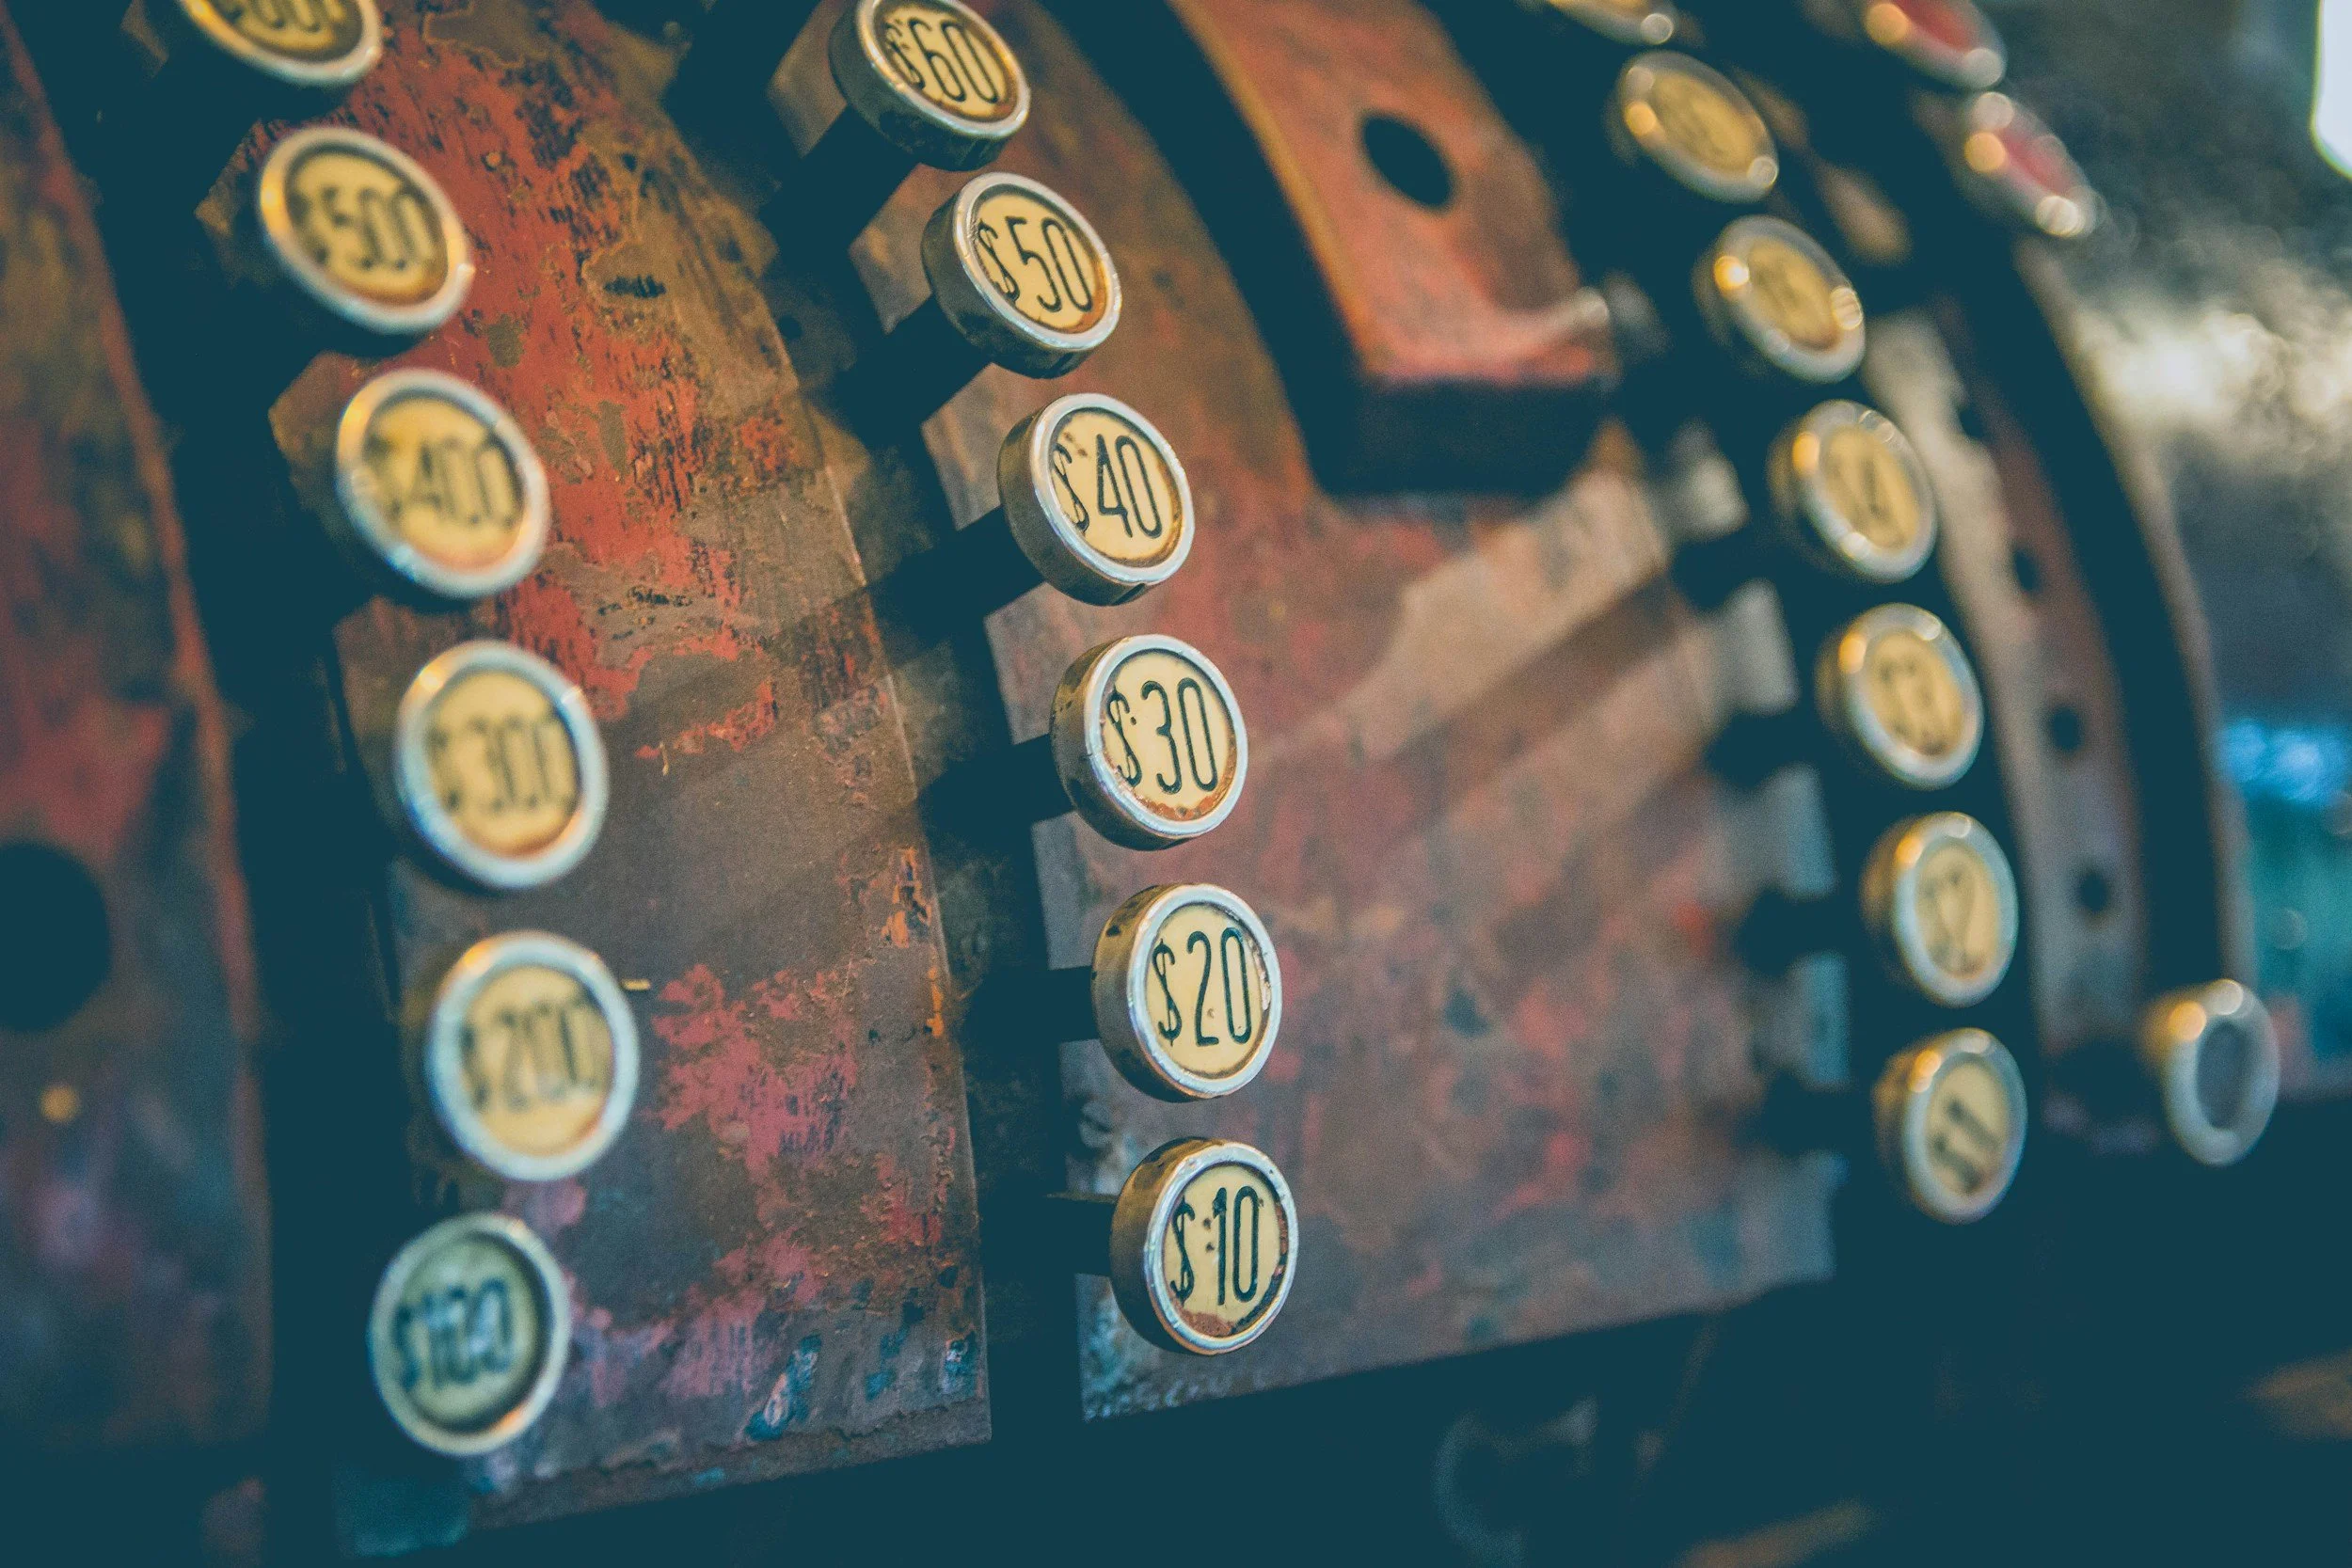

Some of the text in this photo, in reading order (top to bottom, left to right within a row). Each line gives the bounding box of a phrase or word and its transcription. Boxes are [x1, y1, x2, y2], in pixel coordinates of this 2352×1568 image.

[885, 16, 1001, 103] $60
[975, 215, 1093, 313] $50
[1052, 433, 1163, 539] $40
[1105, 676, 1219, 795] $30
[1152, 927, 1252, 1047] $20
[1169, 1185, 1261, 1307] $10
